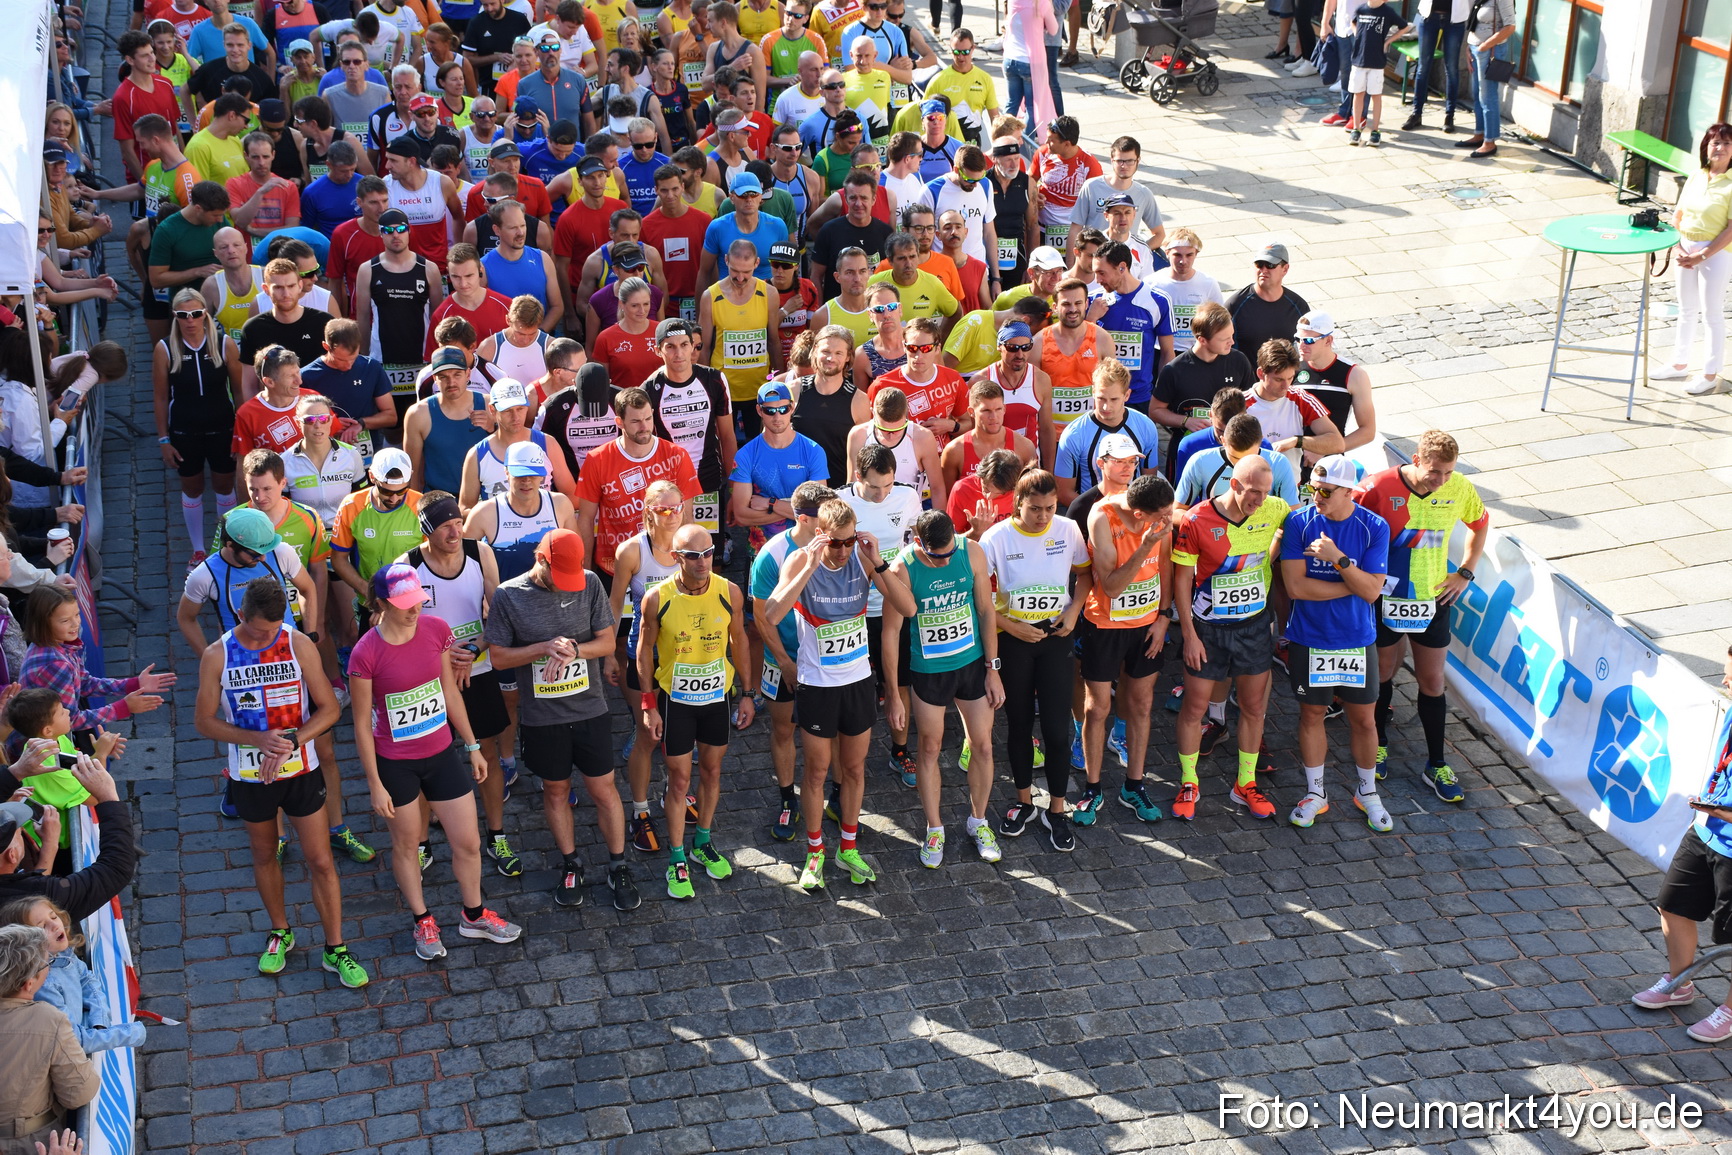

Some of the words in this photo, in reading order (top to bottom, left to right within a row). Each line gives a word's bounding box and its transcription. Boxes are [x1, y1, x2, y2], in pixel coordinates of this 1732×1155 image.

[831, 19, 847, 31] MAX
[630, 188, 658, 196] SYSCA
[772, 246, 796, 256] OAKLEY
[726, 332, 764, 342] BOCK
[729, 343, 763, 356] 1012
[1054, 388, 1092, 398] BOCK
[663, 402, 707, 414] POSITIV
[1056, 400, 1089, 412] 1391
[570, 426, 615, 436] POSITIV
[321, 473, 353, 482] AMBERG
[694, 494, 715, 504] CK
[1045, 539, 1055, 547] 20
[933, 580, 956, 589] Fischer
[1215, 573, 1260, 587] BOCK
[1118, 590, 1156, 608] 1362
[1218, 587, 1260, 605] 2699
[924, 601, 966, 614] NEUMARKT
[1017, 596, 1059, 610] 1367
[1227, 606, 1251, 616] FLO
[1388, 603, 1430, 617] 2682
[922, 609, 967, 626] BOCK
[1393, 618, 1430, 629] THOMAS
[453, 623, 479, 639] CK
[821, 618, 862, 637] BOCK
[926, 621, 968, 643] 2835
[825, 632, 862, 654] 2741
[228, 669, 241, 681] LA
[245, 662, 296, 679] CARRERA
[678, 663, 721, 677] BOCK
[1316, 658, 1360, 672] 2144
[229, 677, 262, 688] TRITEAM
[262, 673, 297, 684] ROTHSEE
[679, 676, 721, 692] 2062
[1317, 675, 1358, 683] ANDREAS
[539, 680, 584, 693] CHRISTIAN
[390, 681, 438, 709] BOCK
[681, 692, 716, 701] JÜRGEN
[396, 699, 441, 726] 2742
[401, 718, 439, 736] THERESA
